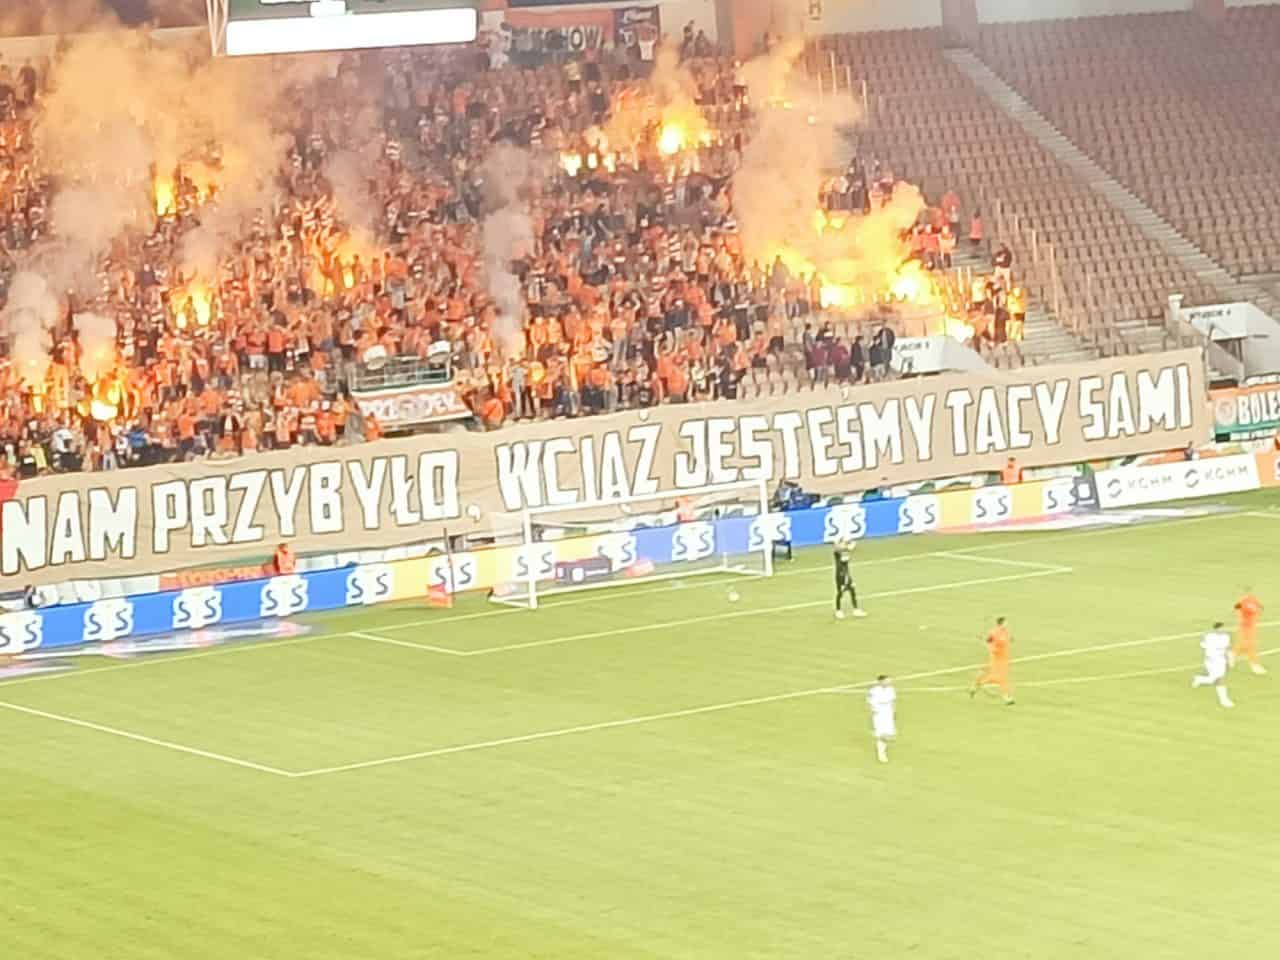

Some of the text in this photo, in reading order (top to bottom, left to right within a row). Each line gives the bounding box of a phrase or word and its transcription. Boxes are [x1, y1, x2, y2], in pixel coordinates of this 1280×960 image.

[0, 486, 138, 576] NAM
[944, 378, 1070, 457] TACY
[1077, 362, 1194, 443] SAMI
